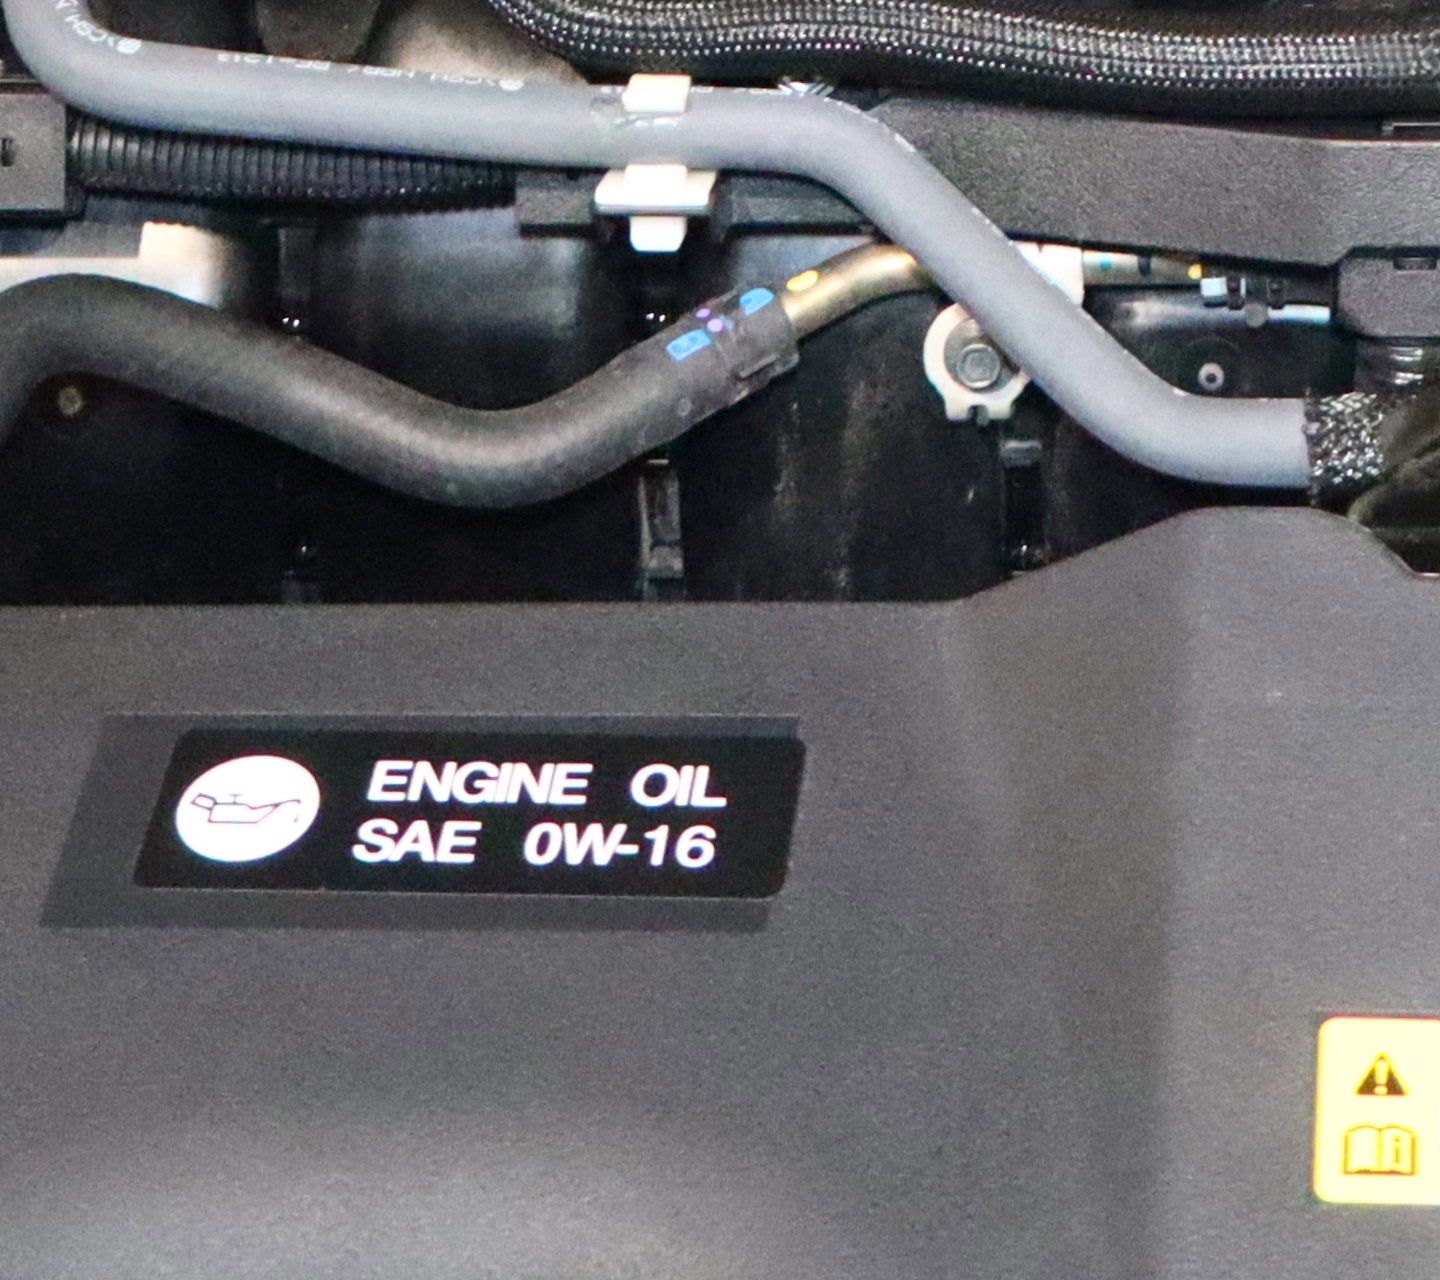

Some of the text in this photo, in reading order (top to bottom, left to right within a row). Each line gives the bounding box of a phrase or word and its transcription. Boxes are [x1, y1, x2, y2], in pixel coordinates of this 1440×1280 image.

[367, 760, 727, 808] ENGINE OIL
[352, 819, 717, 868] SAE 0W-16
